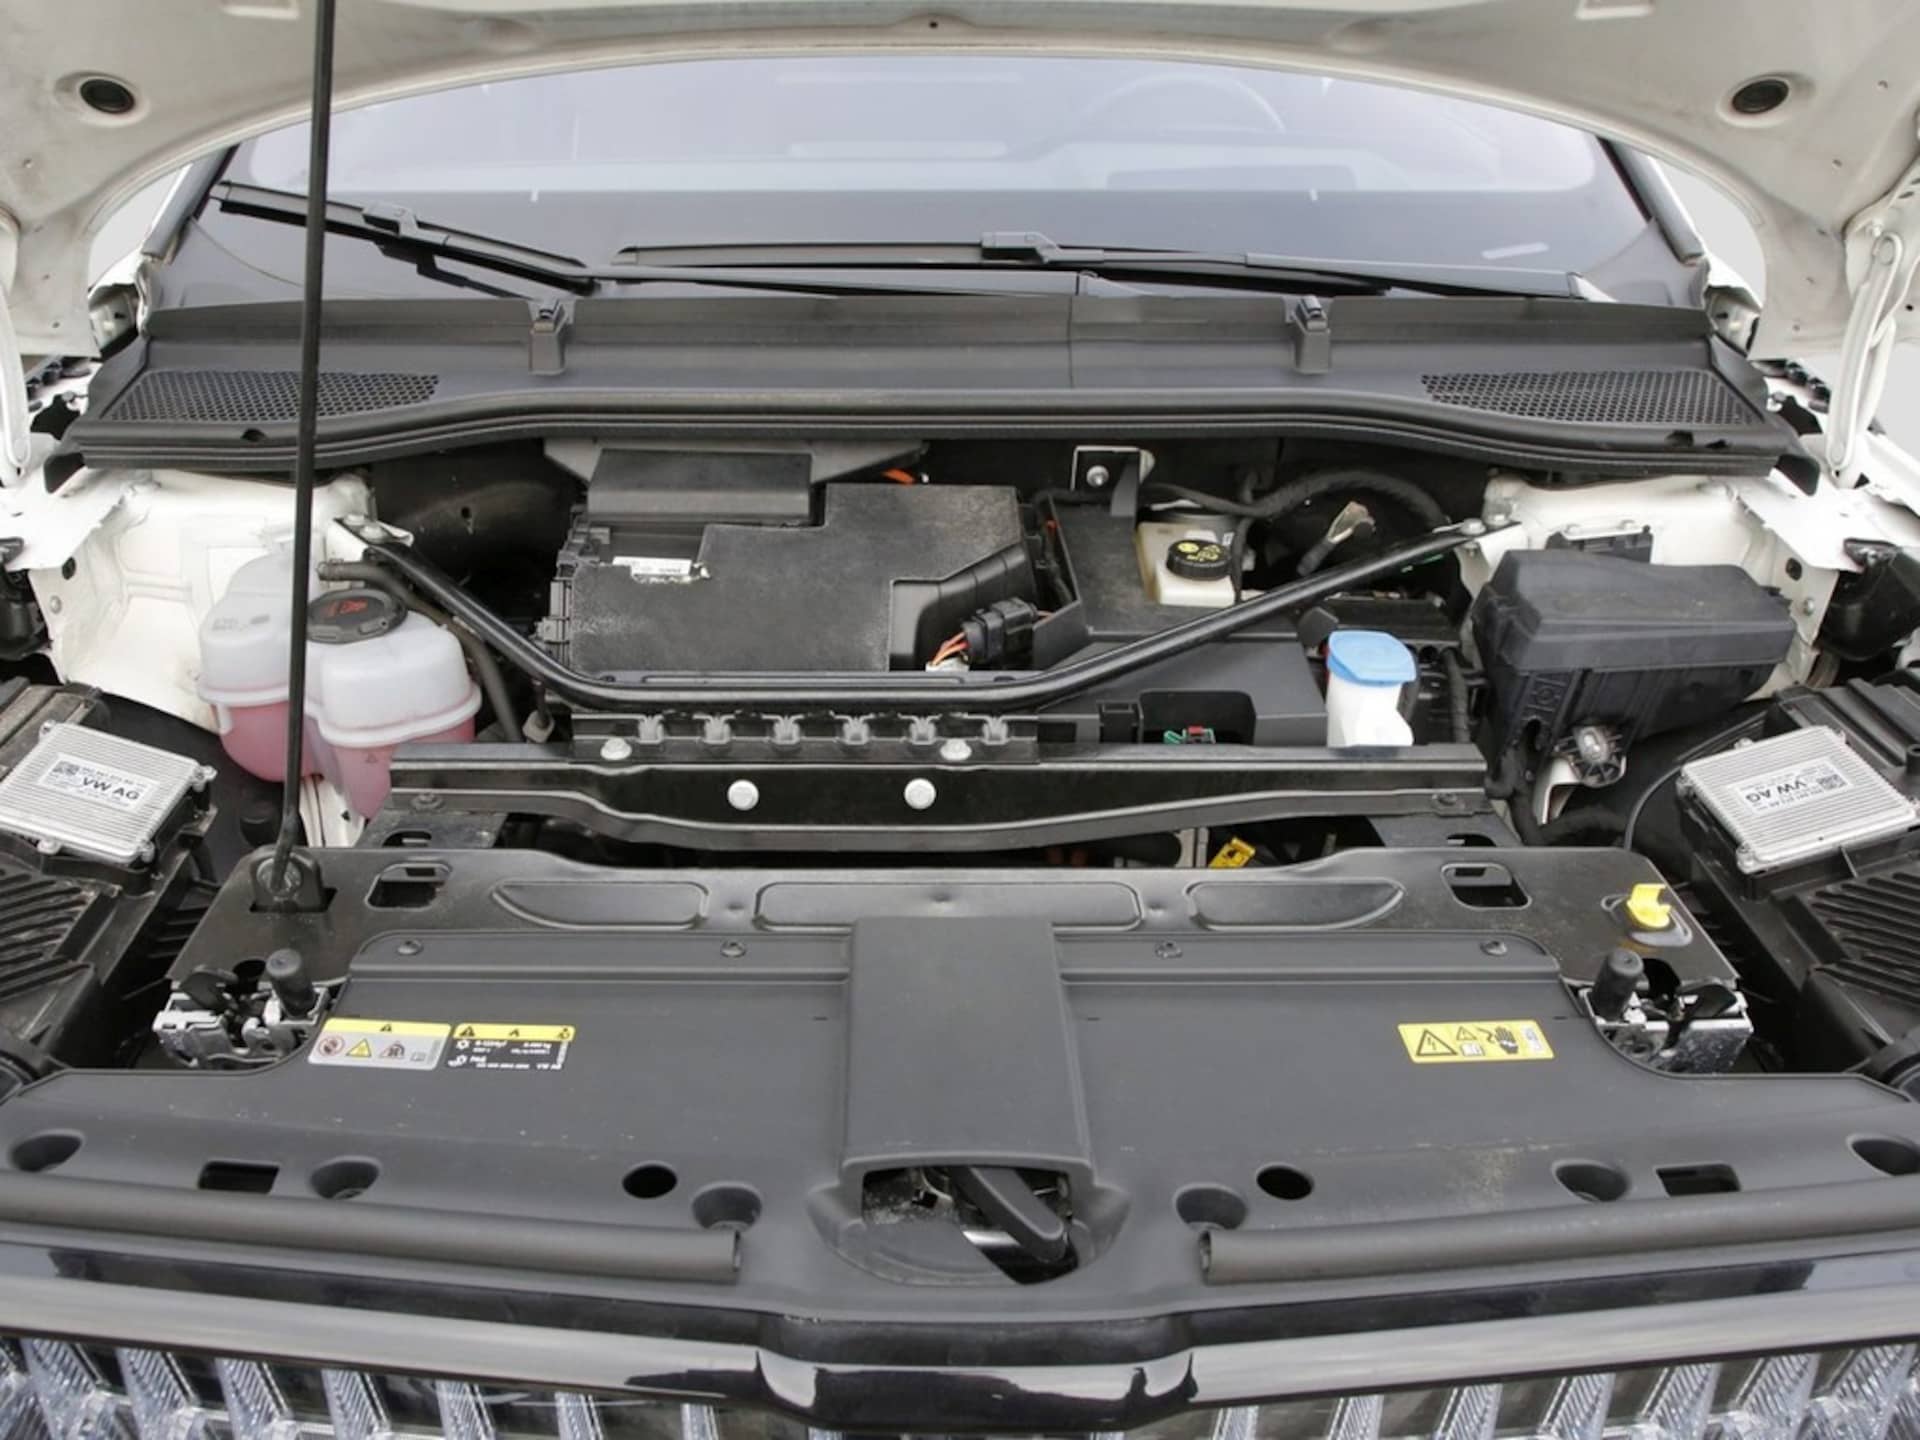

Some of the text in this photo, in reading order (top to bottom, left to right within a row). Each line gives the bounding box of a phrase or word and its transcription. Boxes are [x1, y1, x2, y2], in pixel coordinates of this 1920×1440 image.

[83, 776, 112, 791] VW
[113, 787, 140, 800] AG
[1777, 779, 1807, 795] VW
[1745, 789, 1771, 803] AG
